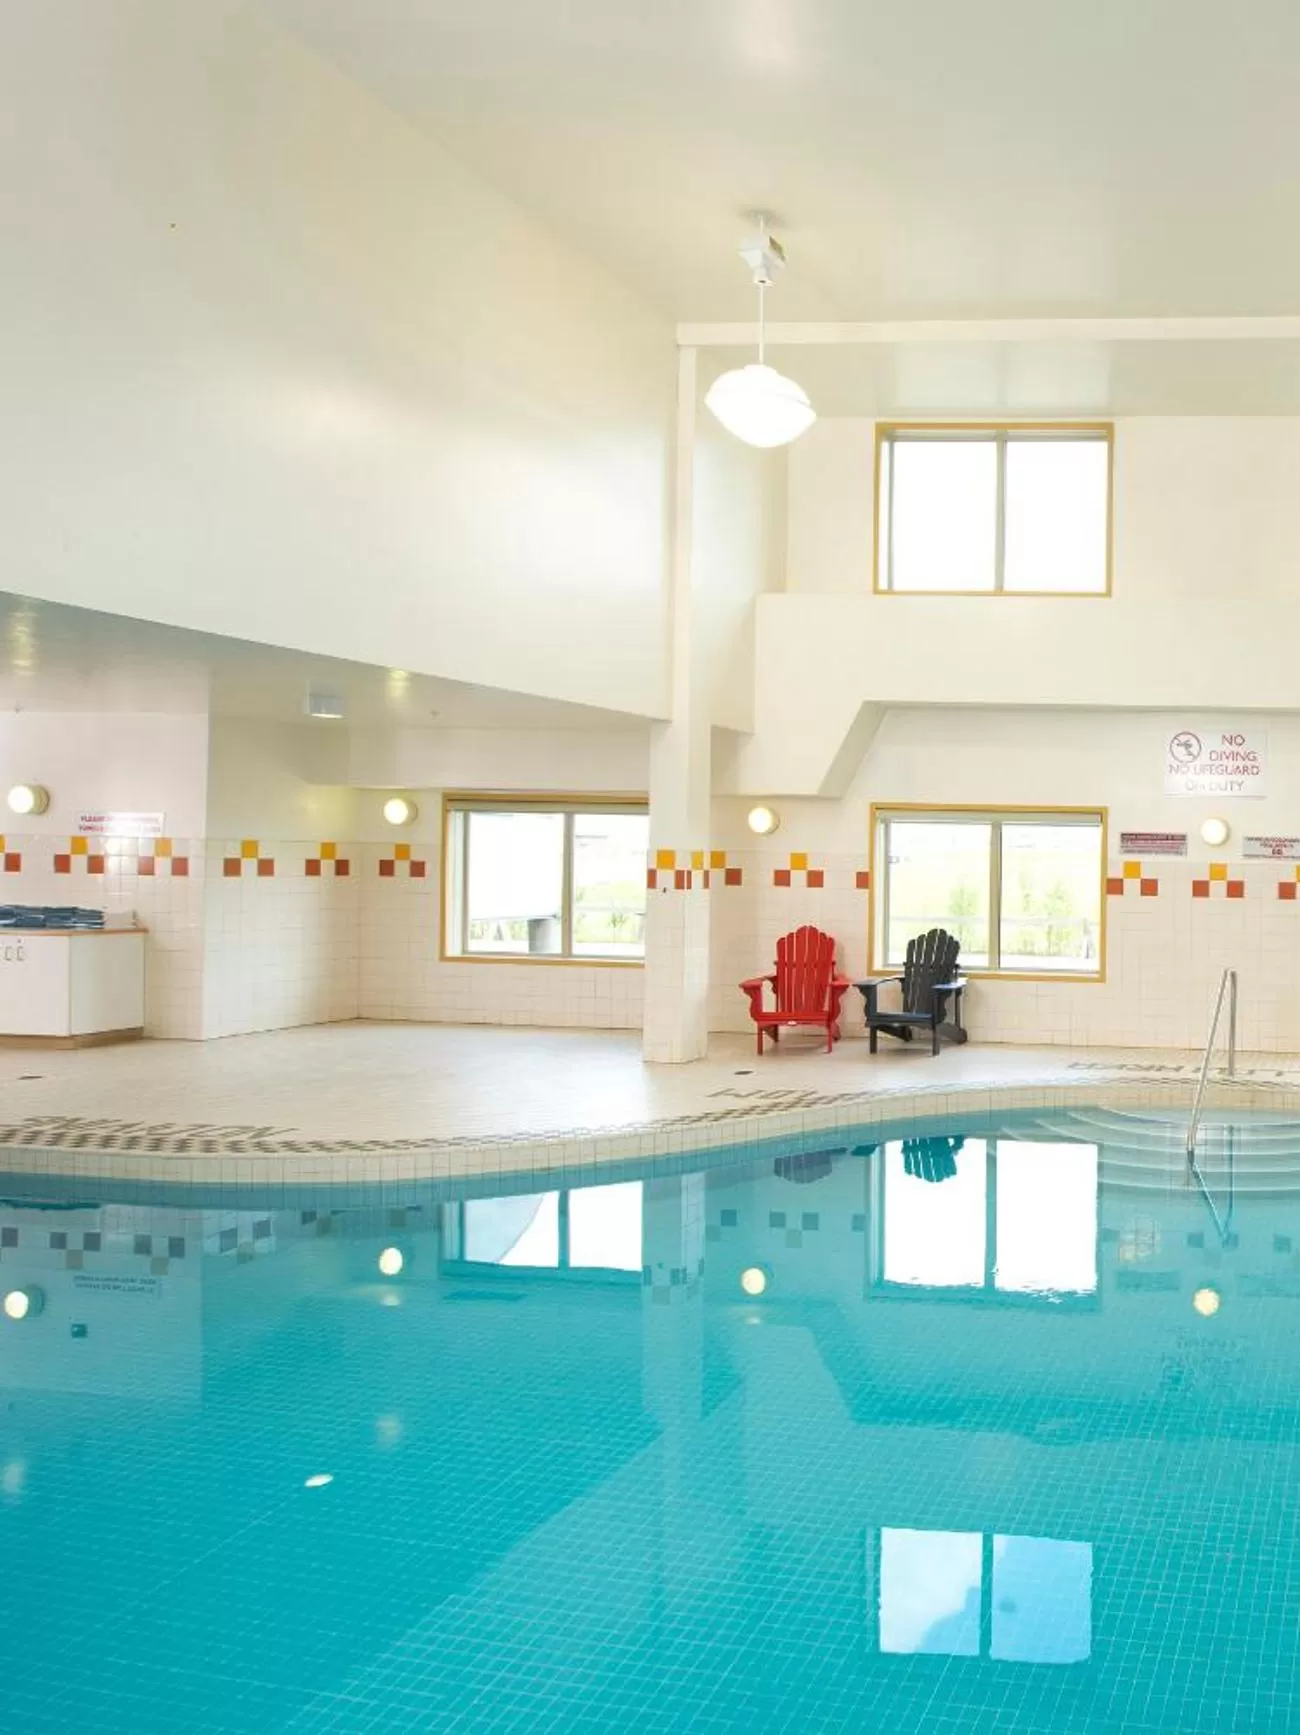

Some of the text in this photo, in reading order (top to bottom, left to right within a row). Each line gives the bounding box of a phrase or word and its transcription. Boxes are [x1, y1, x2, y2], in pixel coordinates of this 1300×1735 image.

[1221, 734, 1246, 746] NO
[1209, 750, 1258, 762] DIVING
[1168, 763, 1260, 776] NO LIFEGUARD
[1209, 780, 1245, 791] DUTY
